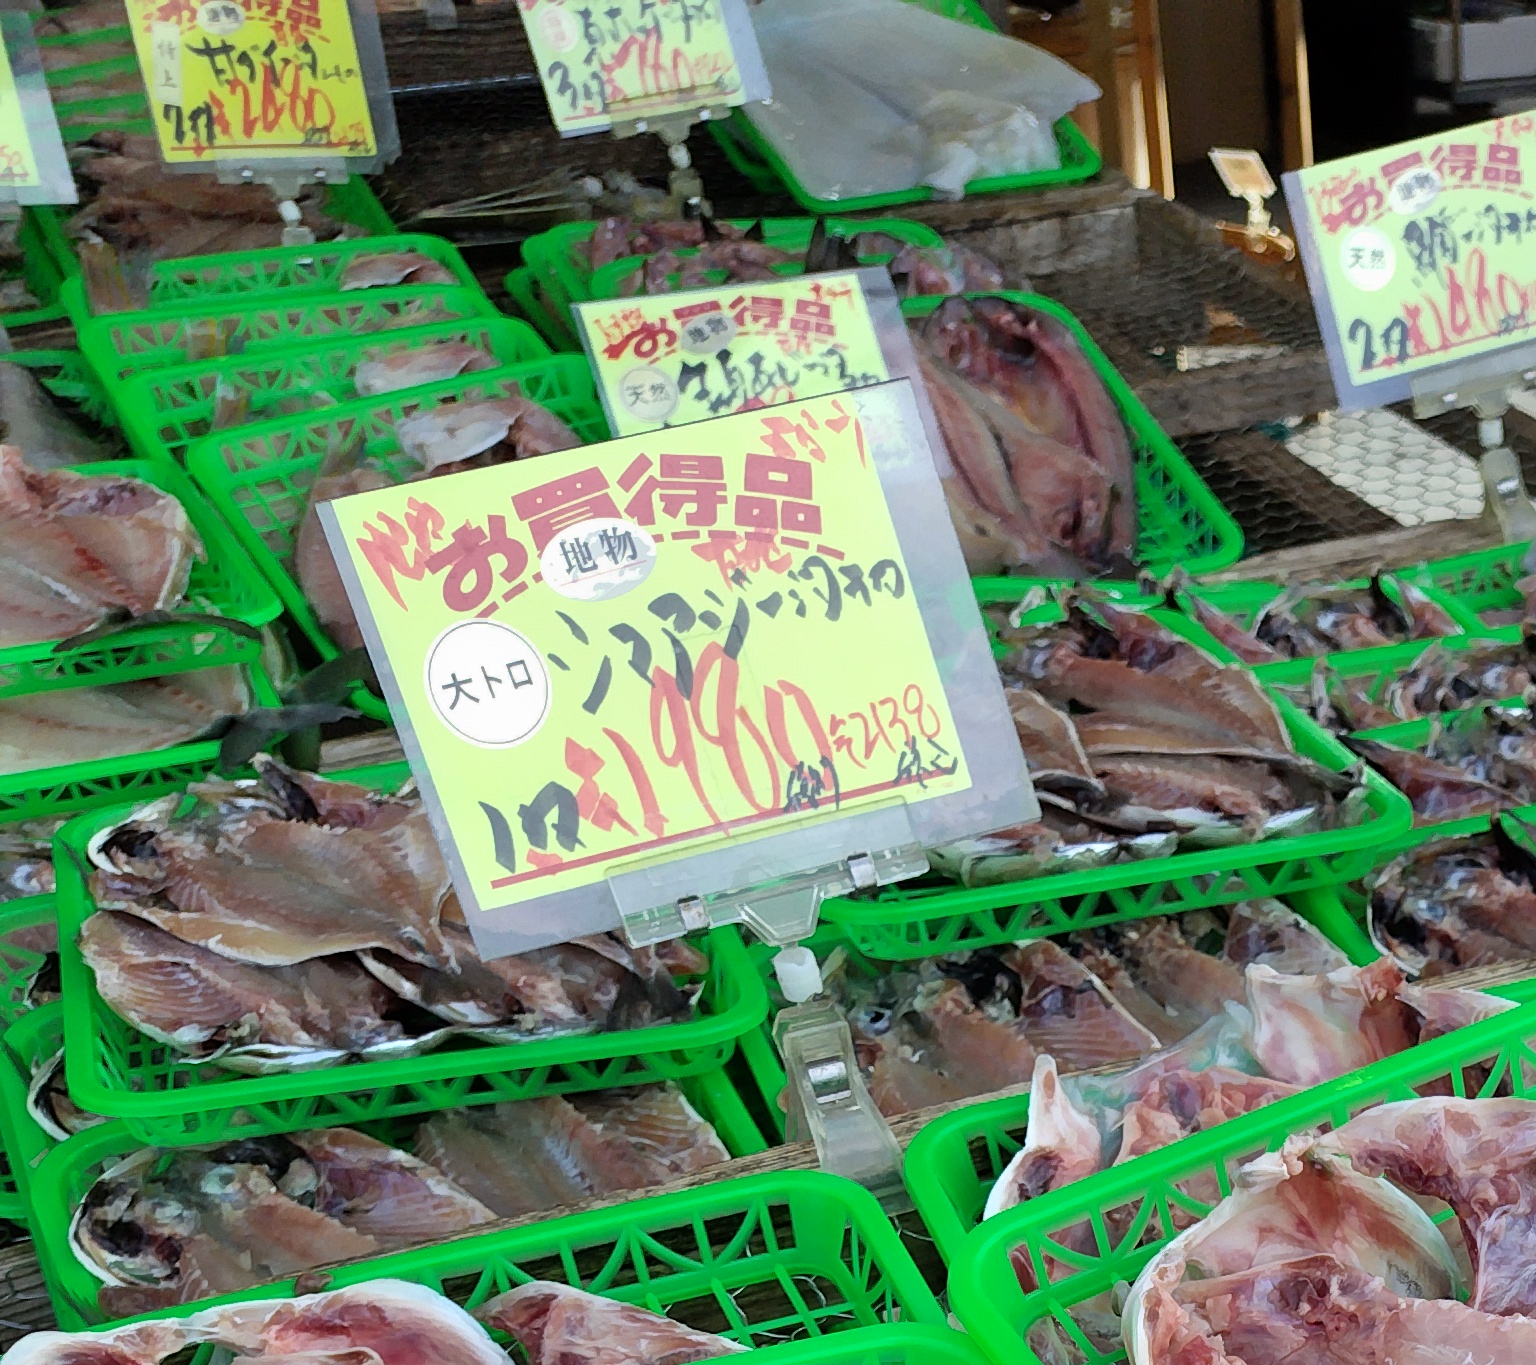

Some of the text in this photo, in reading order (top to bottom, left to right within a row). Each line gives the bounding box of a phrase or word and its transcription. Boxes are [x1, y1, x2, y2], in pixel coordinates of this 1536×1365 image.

[424, 453, 823, 612] お買得品
[560, 527, 637, 574] 地物
[442, 659, 533, 710] 大トロ
